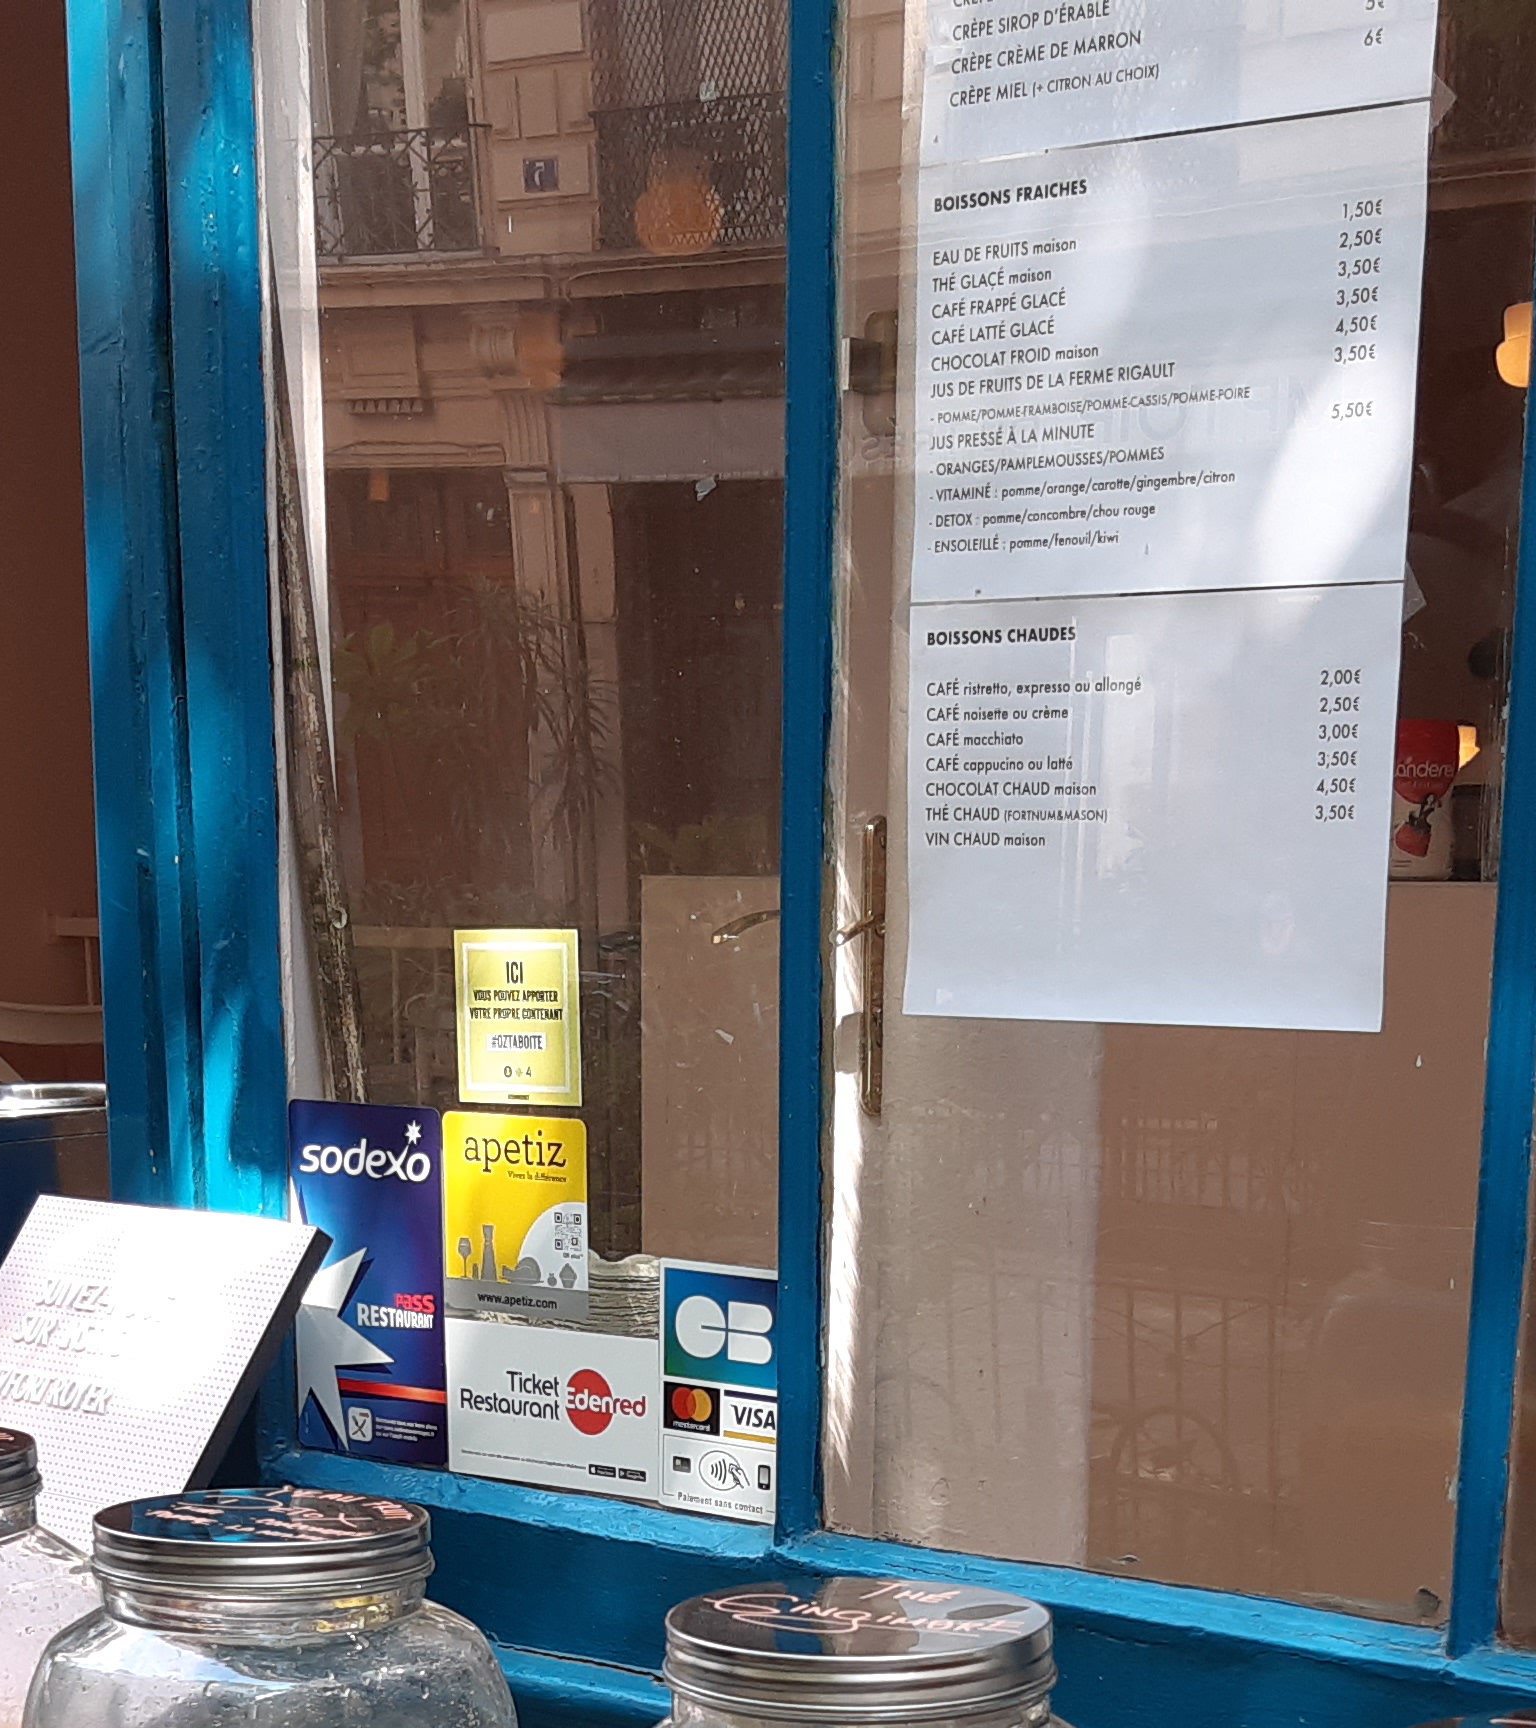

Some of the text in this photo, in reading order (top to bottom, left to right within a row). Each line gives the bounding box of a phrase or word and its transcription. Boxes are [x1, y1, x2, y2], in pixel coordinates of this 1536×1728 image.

[998, 12, 1039, 33] SIROP
[1364, 28, 1383, 46] 6€
[997, 44, 1045, 67] CRÈME
[1050, 41, 1068, 59] DE
[1073, 30, 1142, 55] MARRON
[996, 82, 1027, 101] MIEL
[1047, 76, 1091, 94] CITRON
[1095, 72, 1112, 86] AU
[1116, 63, 1160, 83] CHOIX)
[934, 180, 1087, 212] BOISSONS FRAICHES
[1342, 199, 1383, 221] 1,50€
[1339, 228, 1382, 250] 2,50€
[933, 238, 1077, 266] EAU DE FRUITS maison
[1337, 257, 1381, 279] 3,50€
[932, 273, 956, 292] THÉ
[1008, 268, 1052, 284] maison
[932, 286, 1066, 318] CAFÉ FRAPPÉ GLACÉ
[1336, 286, 1379, 307] 3,50€
[932, 315, 1054, 345] CAFÉ LATTÉ GLACÉ
[1335, 315, 1378, 336] 4,50€
[931, 344, 1099, 371] CHOCOLAT FROID maison
[1334, 344, 1376, 364] 3,50€
[931, 362, 1176, 398] JUS DE FRUITS DE LA FERME RIGAULT
[1331, 401, 1374, 421] 5,50€
[930, 424, 1095, 450] JUS PRESSÉ À LA MINUTE
[936, 480, 991, 501] VITAMINÉ
[935, 514, 973, 528] DETOX
[1123, 503, 1156, 518] rouge
[935, 533, 1000, 553] ENSOLEILLÉ
[927, 626, 1077, 646] BOISSONS CHAUDES
[926, 676, 1142, 698] CAFÉ ristretto, expresso ou allongé
[1320, 669, 1361, 687] 2,00€
[926, 703, 1069, 721] CAFÉ noisette ou crème
[1319, 696, 1360, 714] 2,50€
[926, 728, 1023, 746] CAFÉ macchiato
[1318, 724, 1359, 742] 3,00€
[926, 754, 959, 772] CAFÉ
[963, 757, 1024, 775] cappucino
[1028, 759, 1043, 770] ou
[925, 781, 1097, 796] CHOCOLAT CHAUD maison
[1316, 778, 1356, 796] 4,50€
[925, 804, 1108, 823] THÉ CHAUD (FORTNUM&MASON)
[1315, 805, 1355, 823] 3,50€
[925, 832, 1046, 846] VIN CHAUD maison
[506, 961, 524, 984] ICI
[300, 1138, 431, 1182] sodexo
[464, 1130, 567, 1173] apetiz
[477, 1292, 558, 1309] www.apetiz.com
[357, 1303, 434, 1329] RESTAURANT
[506, 1370, 560, 1397] Ticket
[460, 1386, 647, 1421] Restaurant Edenred
[672, 1420, 711, 1433] mastercard
[730, 1404, 776, 1431] VISA
[715, 1498, 733, 1511] sans
[734, 1501, 764, 1516] contact
